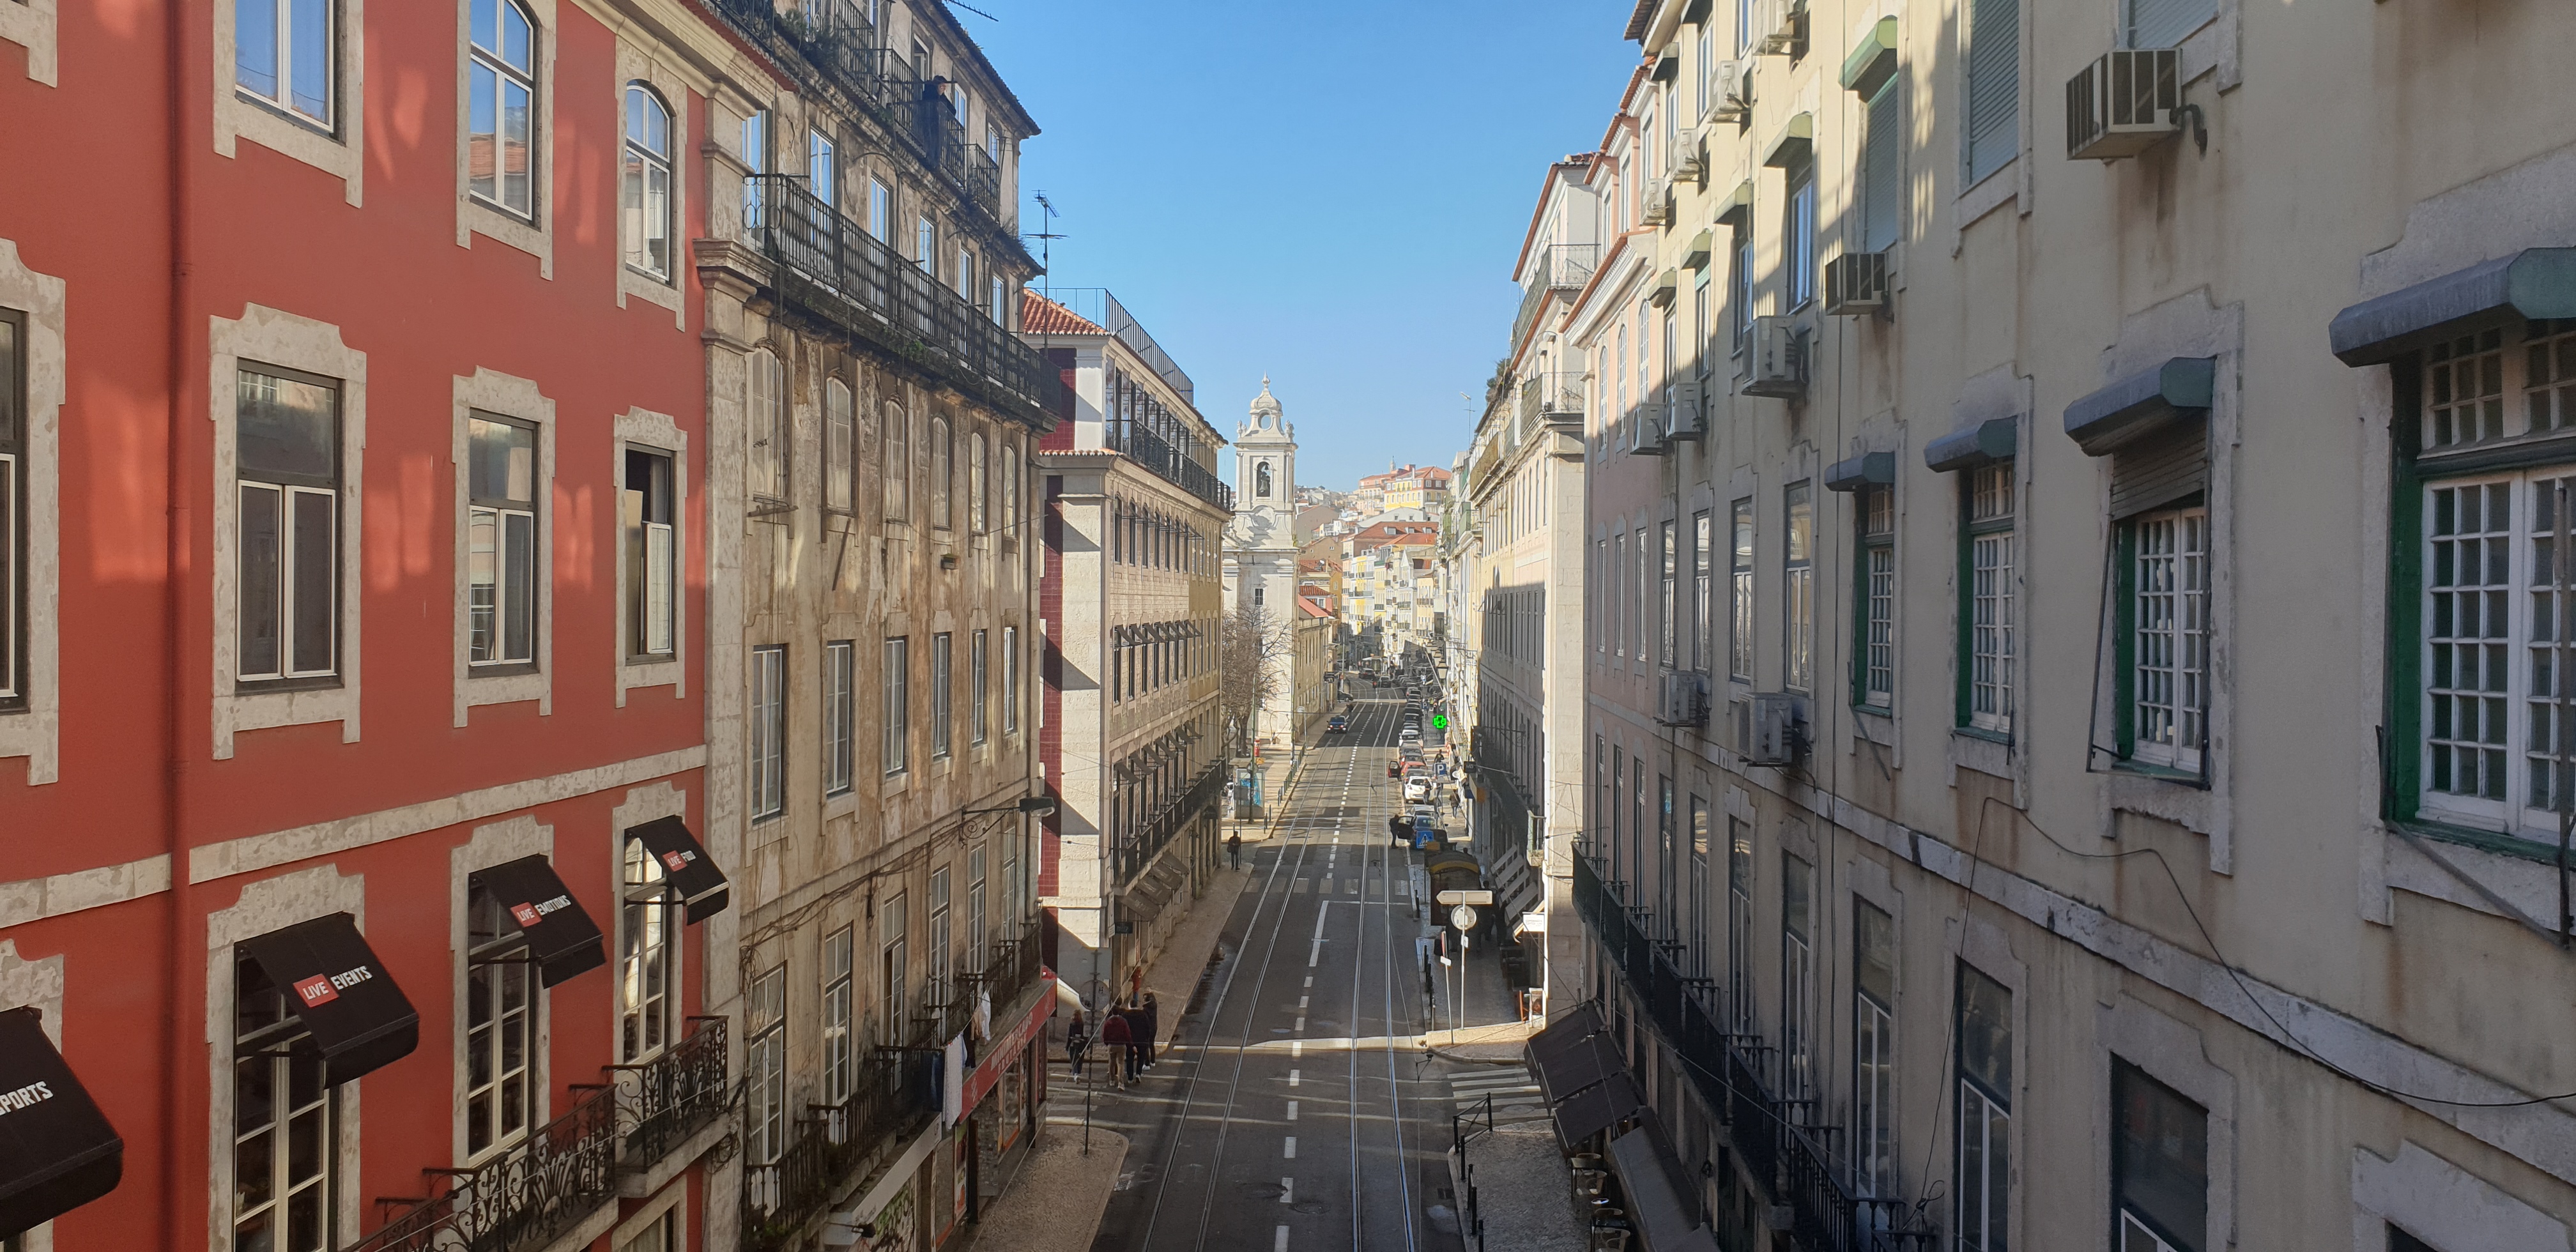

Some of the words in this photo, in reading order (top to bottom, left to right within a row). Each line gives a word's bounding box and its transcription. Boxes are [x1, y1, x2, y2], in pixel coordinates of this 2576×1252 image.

[1438, 765, 1445, 774] P
[668, 855, 682, 867] LIVE
[517, 908, 535, 922] LIVE
[534, 894, 572, 916] EMOTIONS
[302, 981, 330, 1000] LIVE
[330, 965, 373, 990] EVENTS
[990, 1011, 1033, 1072] MINIMERCADO
